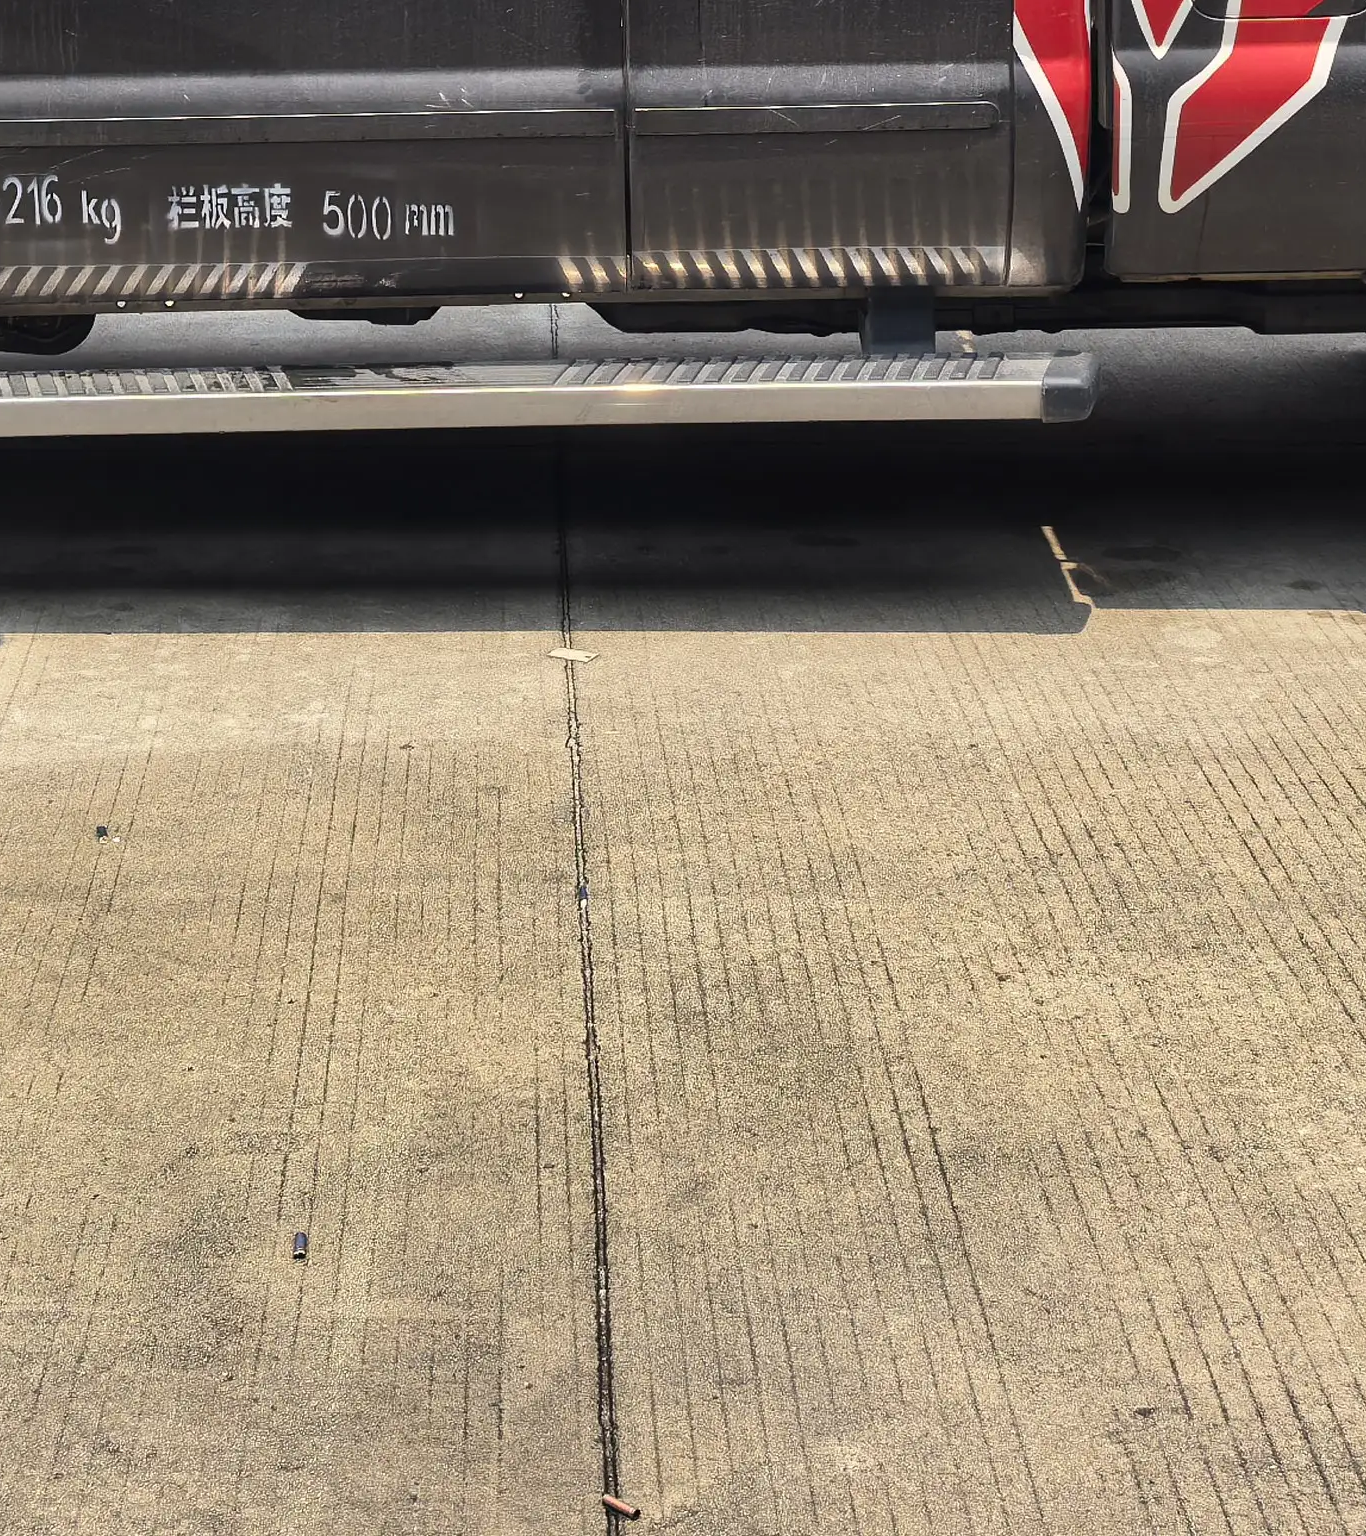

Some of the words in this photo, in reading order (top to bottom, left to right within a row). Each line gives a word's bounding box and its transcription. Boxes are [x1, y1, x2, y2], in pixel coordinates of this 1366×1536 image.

[81, 189, 122, 244] kg
[167, 183, 293, 231] 栏板高度
[322, 190, 393, 240] 500
[404, 203, 456, 237] mm
